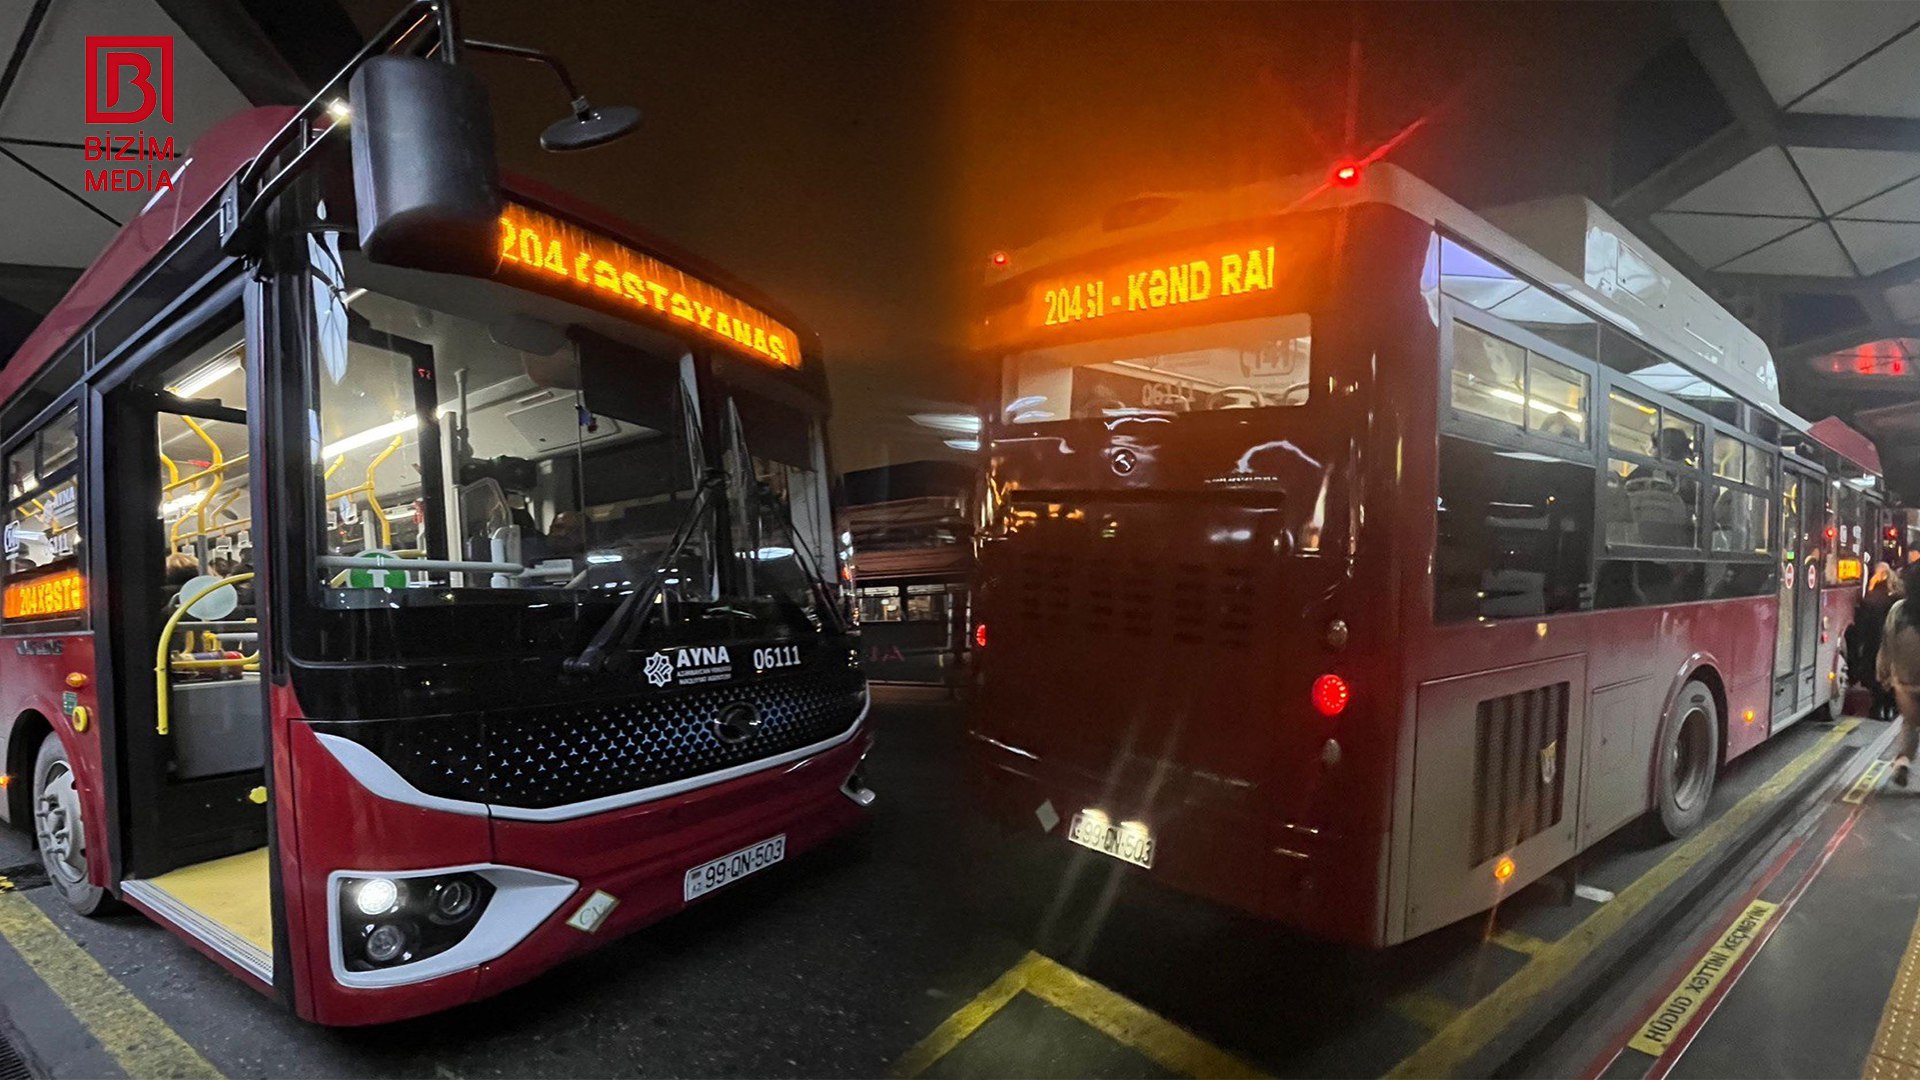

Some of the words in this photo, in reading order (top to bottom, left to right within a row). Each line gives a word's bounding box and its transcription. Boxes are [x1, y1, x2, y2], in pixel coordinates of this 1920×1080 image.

[499, 217, 568, 276] 204
[1045, 285, 1083, 325] 204
[1127, 260, 1211, 311] KƏND
[676, 645, 730, 667] AYNA
[753, 645, 801, 669] 06111
